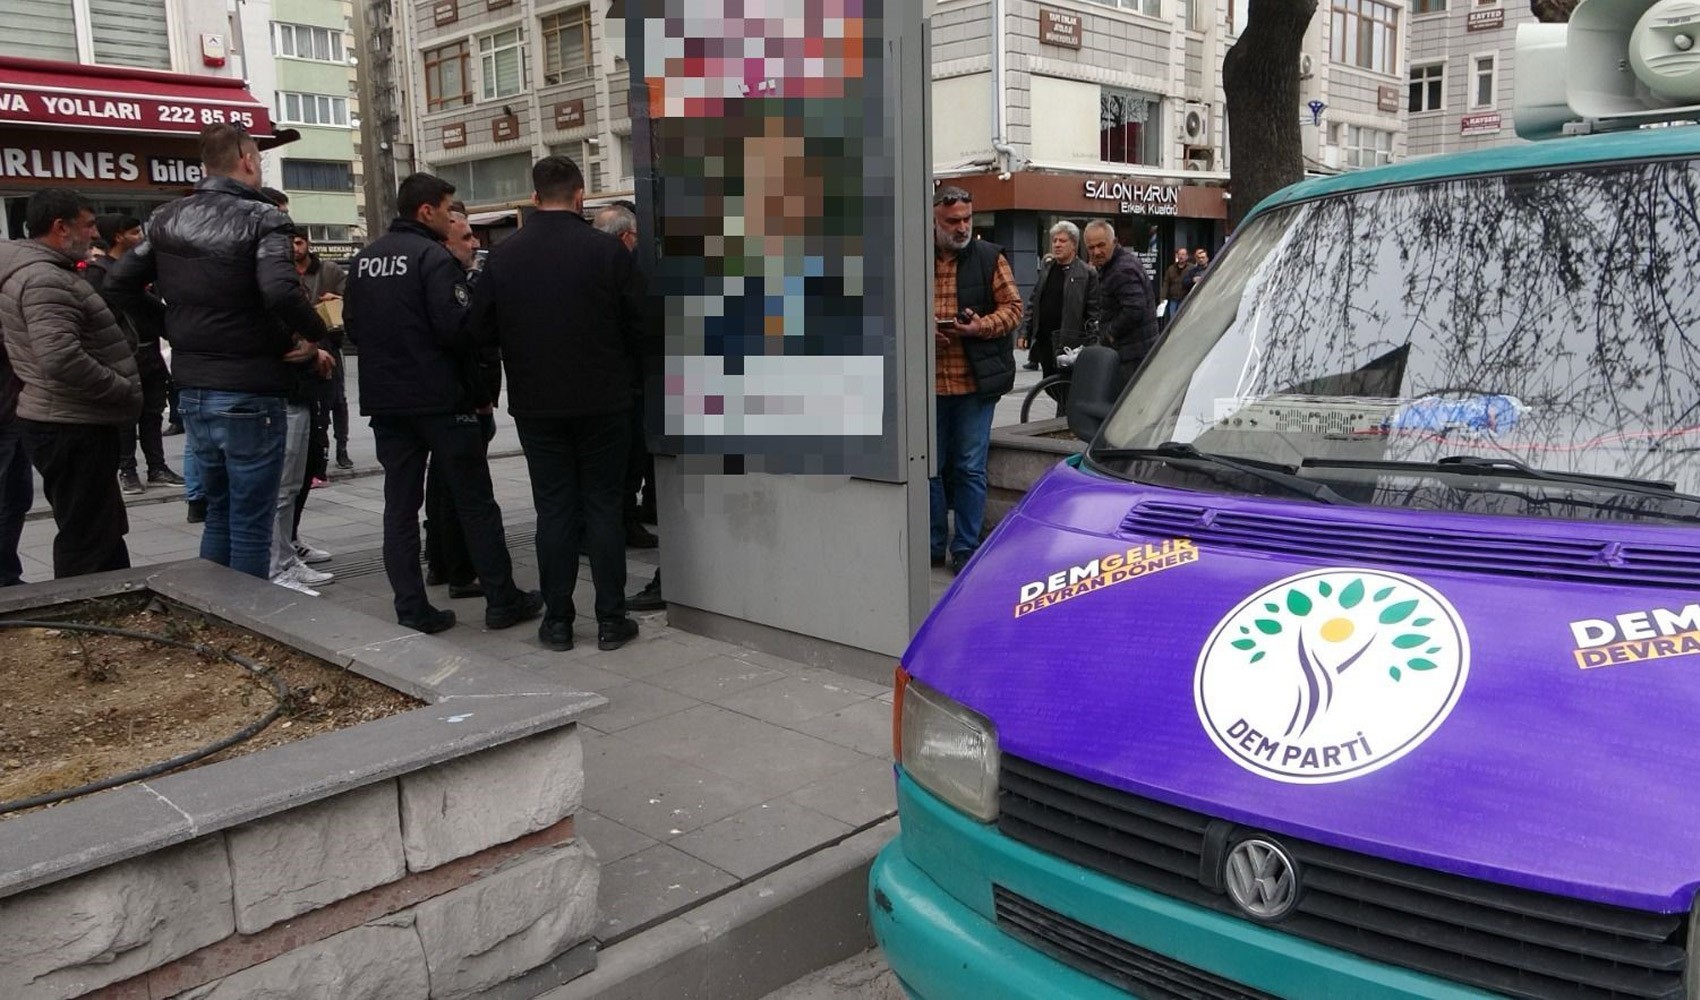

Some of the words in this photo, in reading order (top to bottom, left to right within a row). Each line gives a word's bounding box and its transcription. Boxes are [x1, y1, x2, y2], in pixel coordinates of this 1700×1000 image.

[41, 96, 141, 120] YOLLARI
[158, 105, 196, 123] 222
[200, 108, 225, 125] 85
[229, 110, 254, 128] 85
[0, 148, 139, 181] RLINES
[1085, 180, 1132, 201] SALON
[1133, 184, 1178, 203] HARUN
[1121, 201, 1146, 214] Erkek
[1018, 577, 1106, 616] DEVRAN
[1111, 550, 1194, 582] DÖNER
[1569, 604, 1700, 648] DEM
[1226, 718, 1280, 762] DEM
